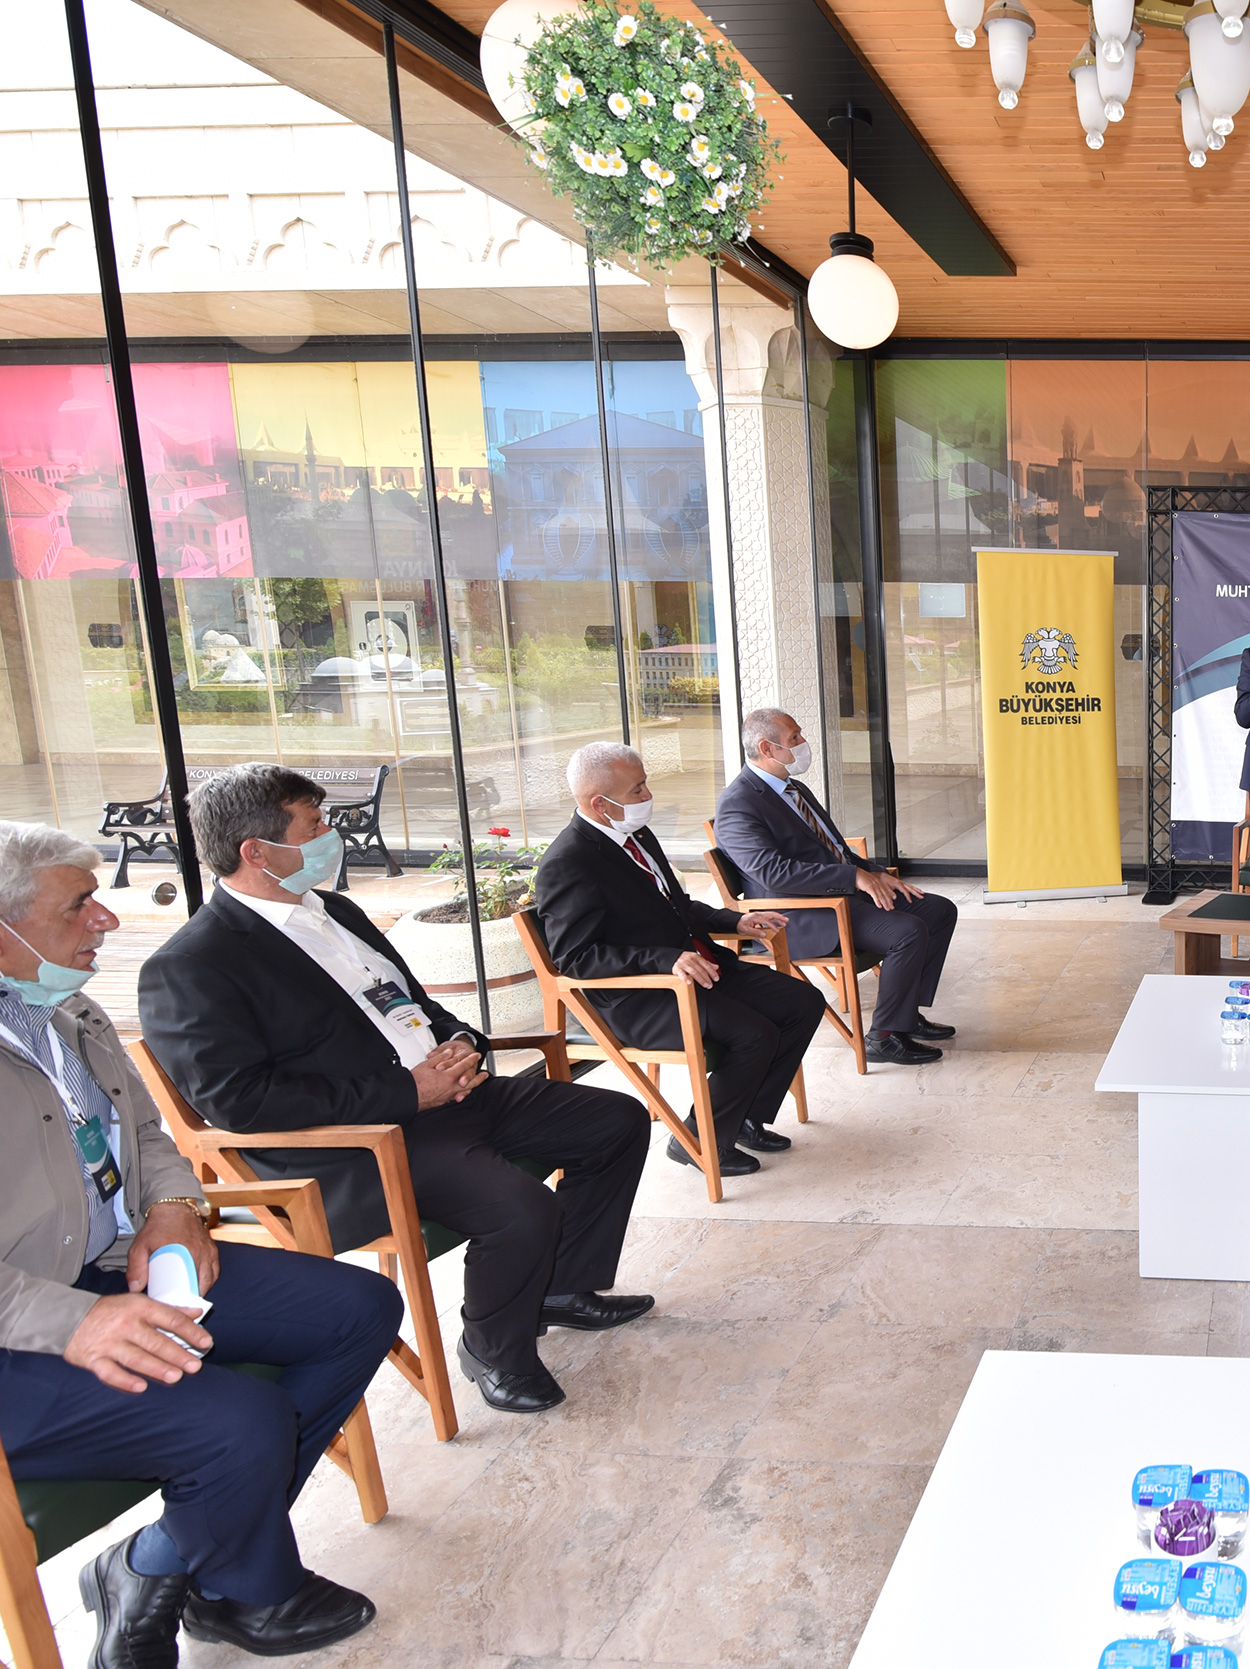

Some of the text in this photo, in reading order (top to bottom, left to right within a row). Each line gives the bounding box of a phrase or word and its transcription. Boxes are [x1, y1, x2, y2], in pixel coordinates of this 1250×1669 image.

[1025, 681, 1076, 694] KONYA
[999, 694, 1101, 715] BÜYÜKŞEHİR
[1021, 714, 1081, 725] BELEDİYESİ
[1196, 1565, 1216, 1598] beysu
[1121, 1582, 1160, 1599] beysu
